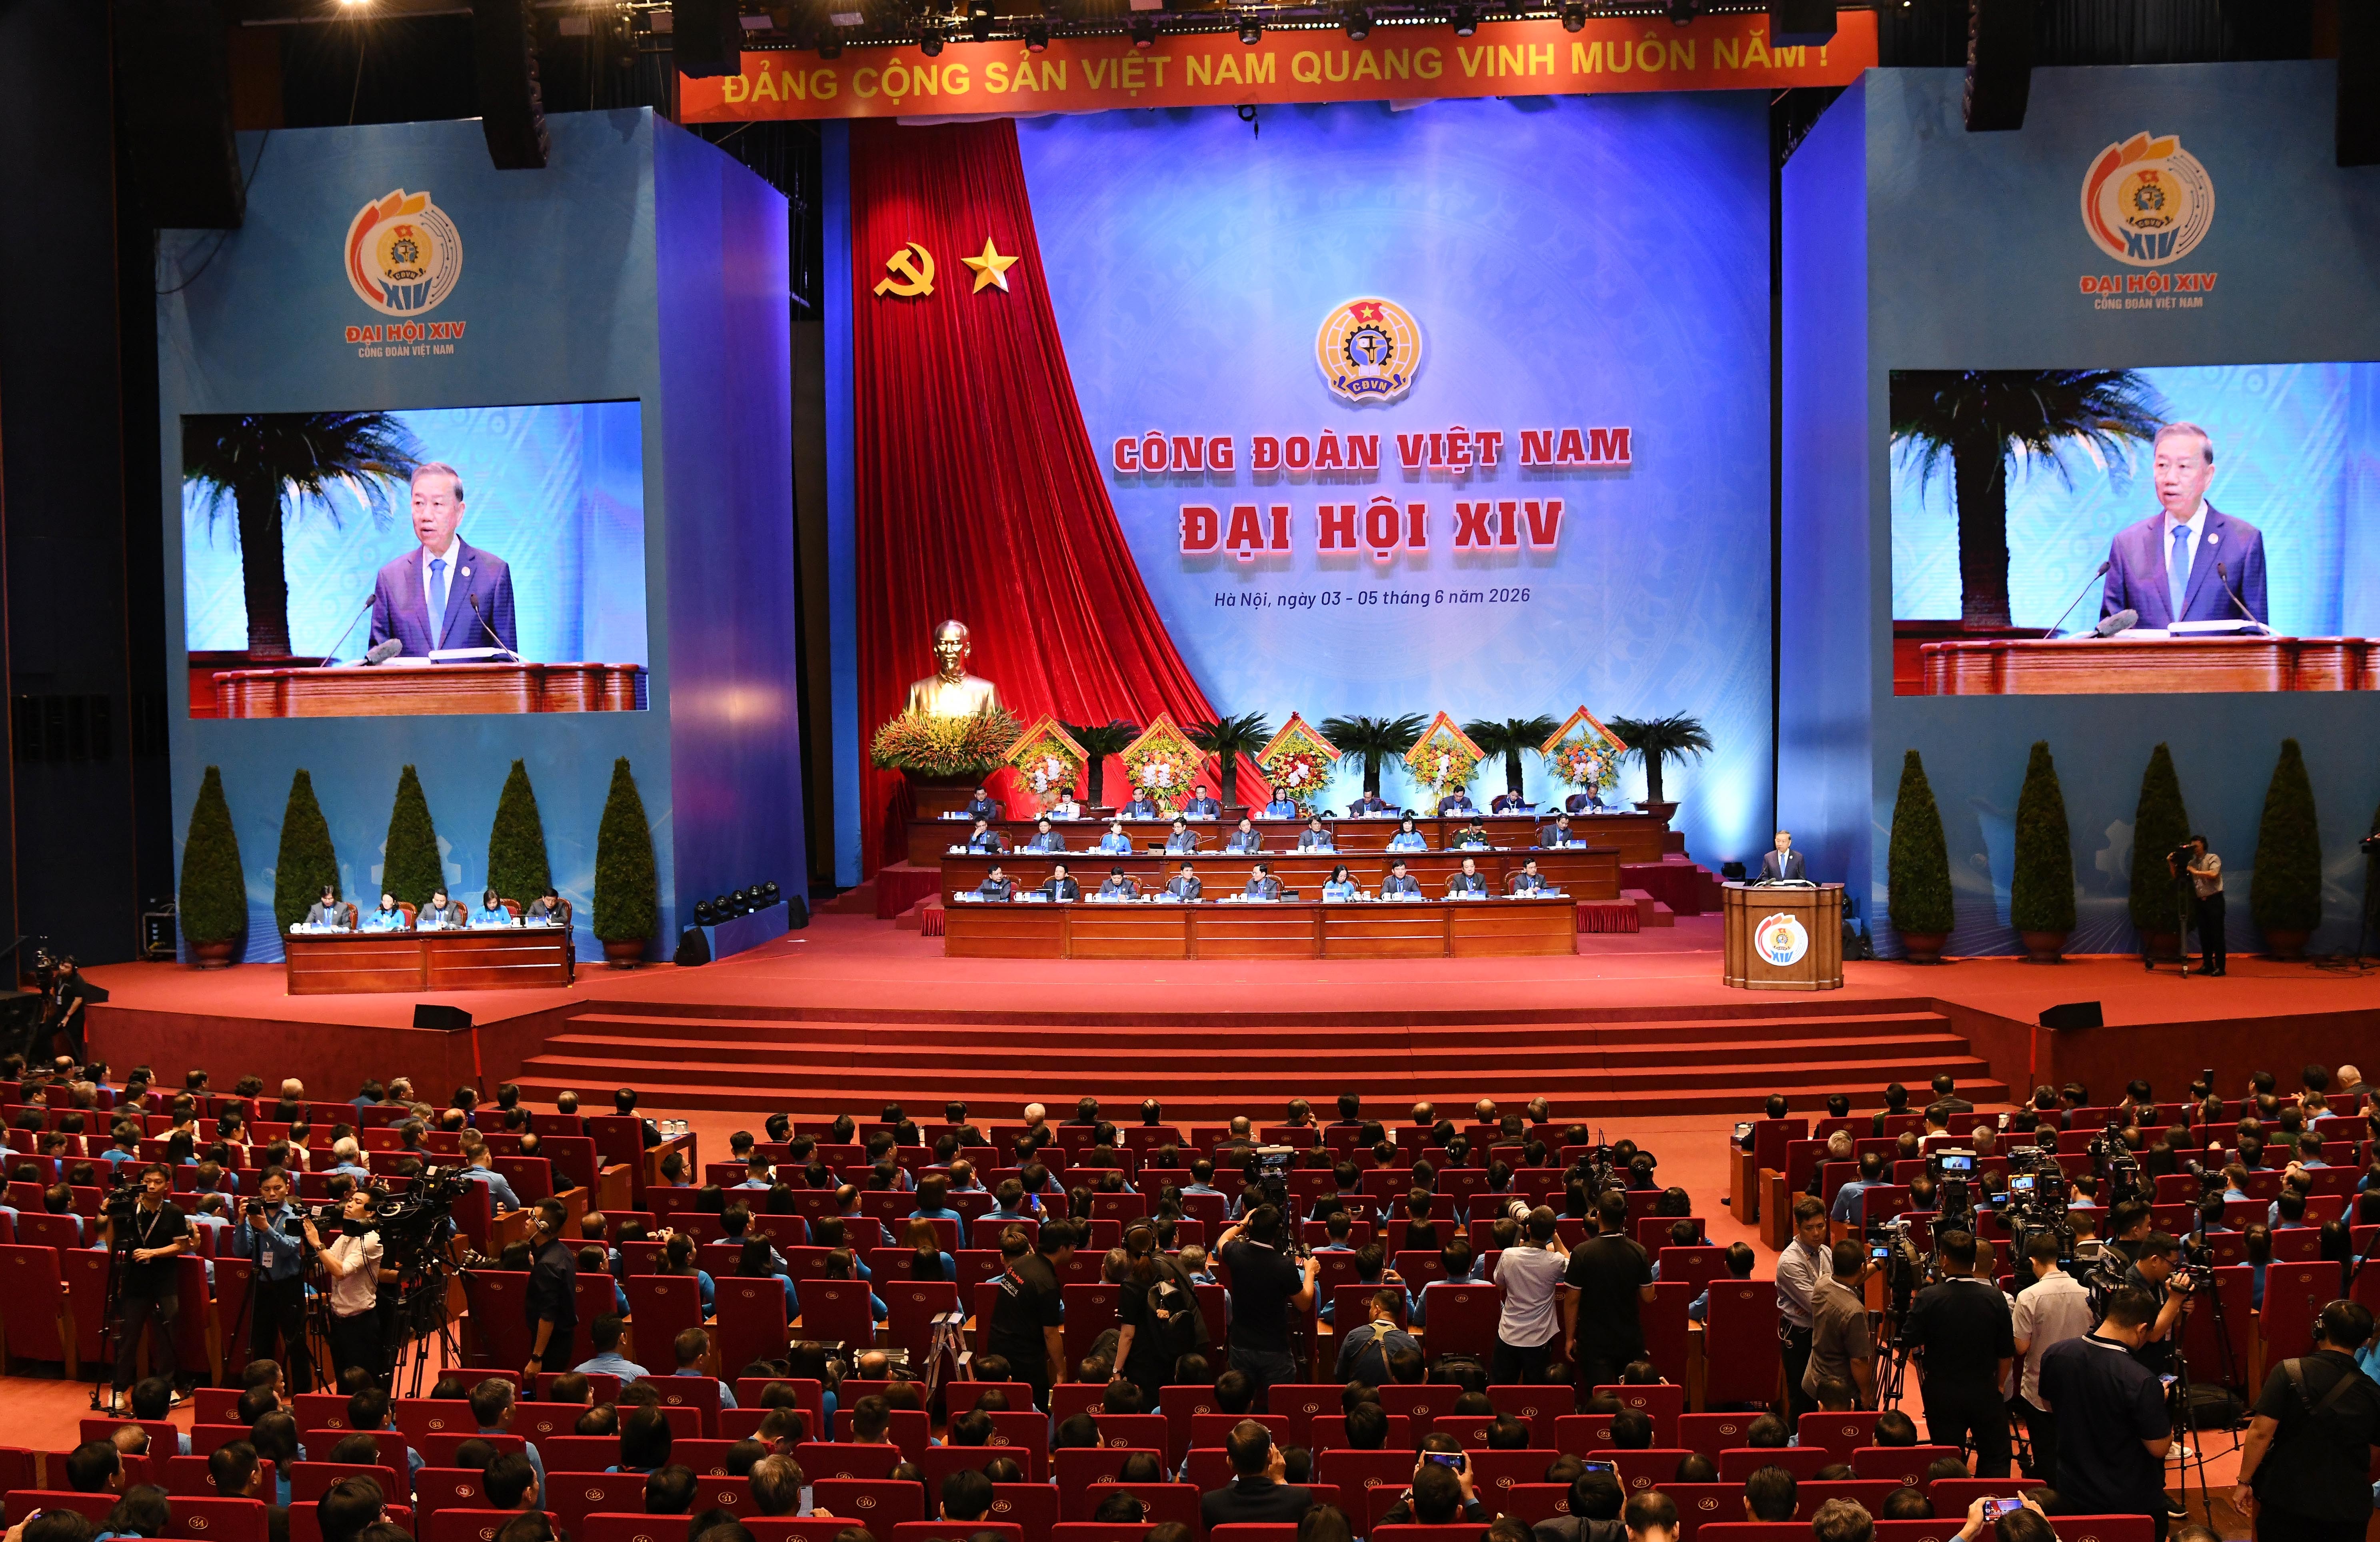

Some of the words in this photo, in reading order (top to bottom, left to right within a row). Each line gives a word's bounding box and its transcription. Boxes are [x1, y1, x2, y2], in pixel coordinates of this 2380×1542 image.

[722, 60, 835, 102] ĐẢNG
[854, 58, 970, 105] CỘNG
[985, 50, 1066, 93] SẢN
[1083, 49, 1171, 96] VIỆT
[1187, 52, 1275, 86] NAM
[1292, 48, 1442, 84] QUANG
[1458, 42, 1555, 77] VINH
[1572, 32, 1696, 74] MUÔN
[1713, 29, 1805, 68] NĂM
[2118, 226, 2181, 260] XIV
[378, 277, 433, 310] XIV
[2080, 275, 2122, 296] ĐẠI
[2127, 270, 2170, 296] HỘI
[2174, 273, 2217, 292] XIV
[2095, 296, 2122, 310] CÔNG
[2125, 297, 2152, 309] ĐOÀN
[2155, 296, 2176, 310] VIỆT
[2179, 297, 2203, 308] NAM
[346, 325, 382, 346] ĐẠI
[387, 320, 424, 344] HỘI
[428, 321, 466, 340] XIV
[359, 344, 382, 358] CÔNG
[386, 344, 410, 357] ĐOÀN
[413, 344, 430, 358] VIỆT
[433, 344, 454, 354] NAM
[1352, 380, 1388, 392] CĐVN
[1114, 430, 1234, 471] CÔNG
[1253, 428, 1379, 469] ĐOÀN
[1396, 425, 1503, 471] VIỆT
[1520, 428, 1630, 464] NAM
[1182, 505, 1289, 558] ĐẠI
[1318, 495, 1427, 558] HỘI
[1455, 500, 1564, 547] XIV
[1215, 592, 1236, 606] Hà
[1241, 592, 1271, 610] Nội,
[1277, 592, 1316, 610] ngày
[1321, 591, 1341, 606] 03
[1358, 591, 1378, 605] 05
[1383, 590, 1430, 608] tháng
[1435, 590, 1444, 604] 6
[1449, 590, 1483, 603] năm
[1489, 588, 1530, 602] 2026
[1770, 949, 1794, 962] XIV
